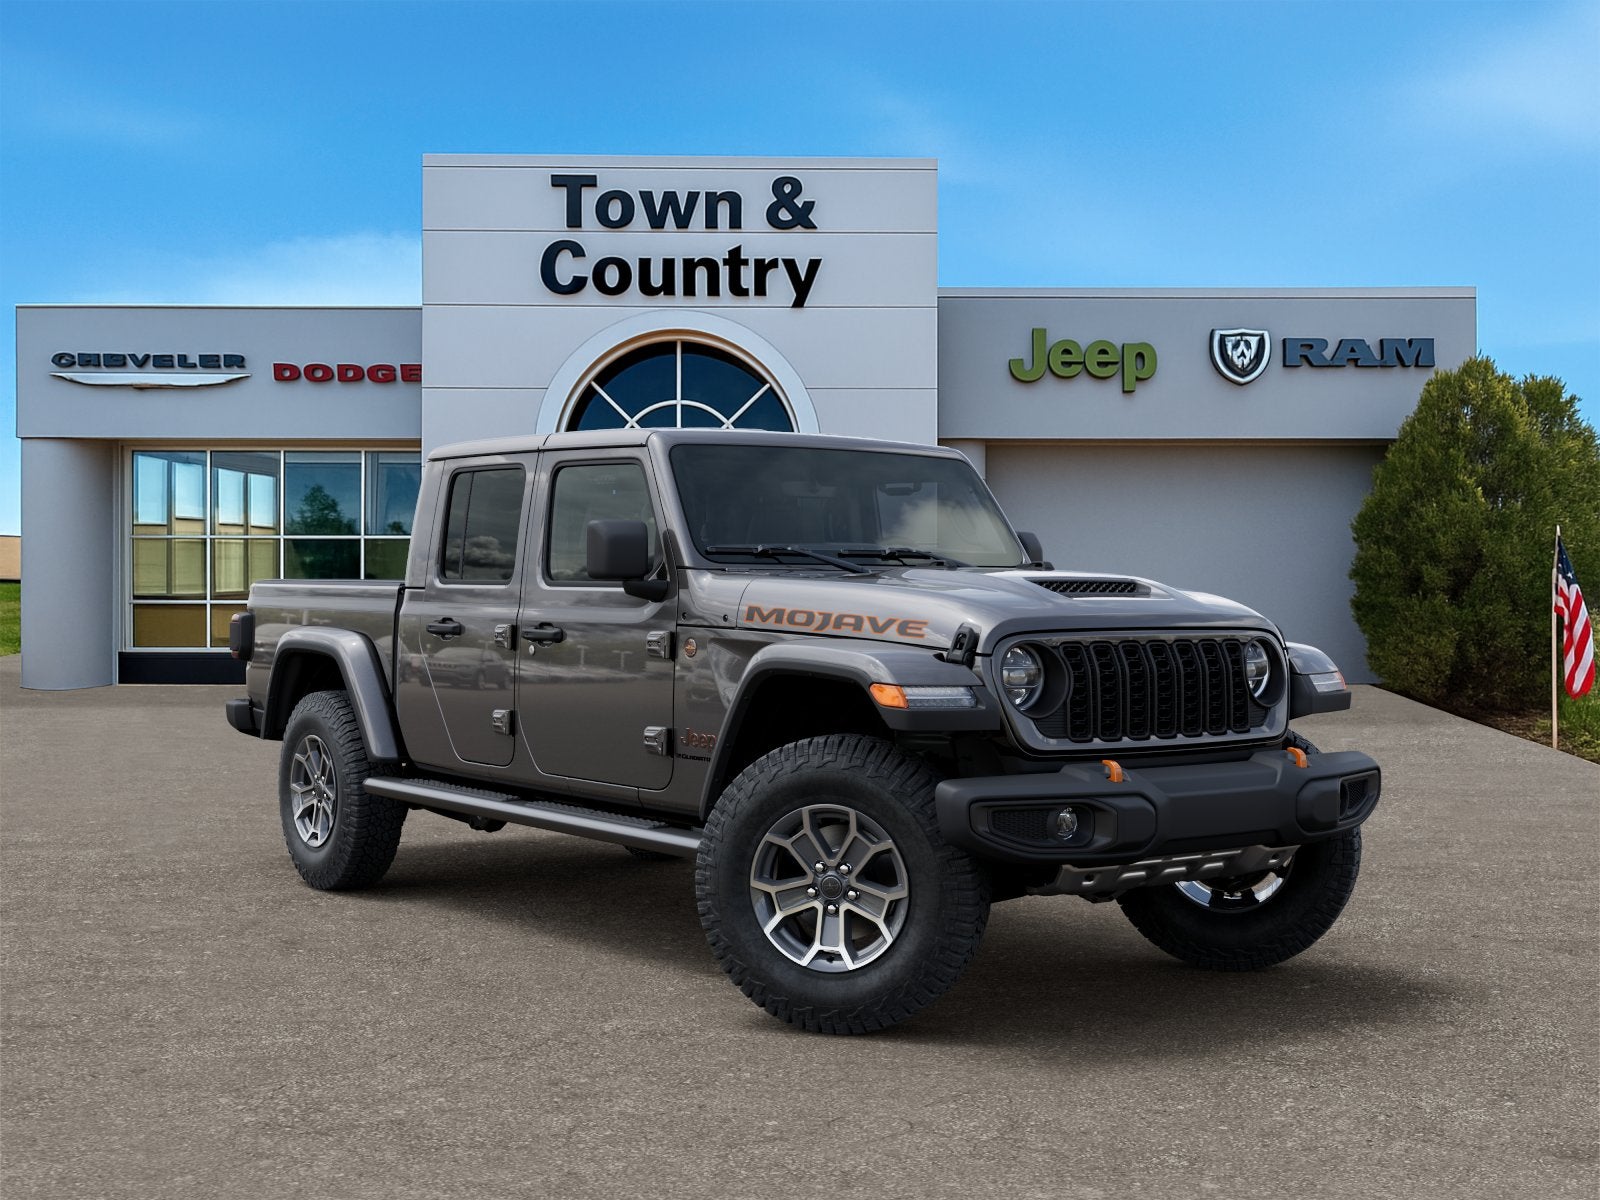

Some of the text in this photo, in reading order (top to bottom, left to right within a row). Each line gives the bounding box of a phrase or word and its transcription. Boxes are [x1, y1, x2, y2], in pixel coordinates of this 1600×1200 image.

[550, 174, 818, 229] Town &
[540, 239, 822, 308] Country
[1009, 328, 1157, 393] Jeep
[1282, 337, 1435, 367] RAM
[273, 362, 422, 383] DODGE
[745, 605, 929, 638] MOJAVE
[680, 727, 717, 753] Jeep
